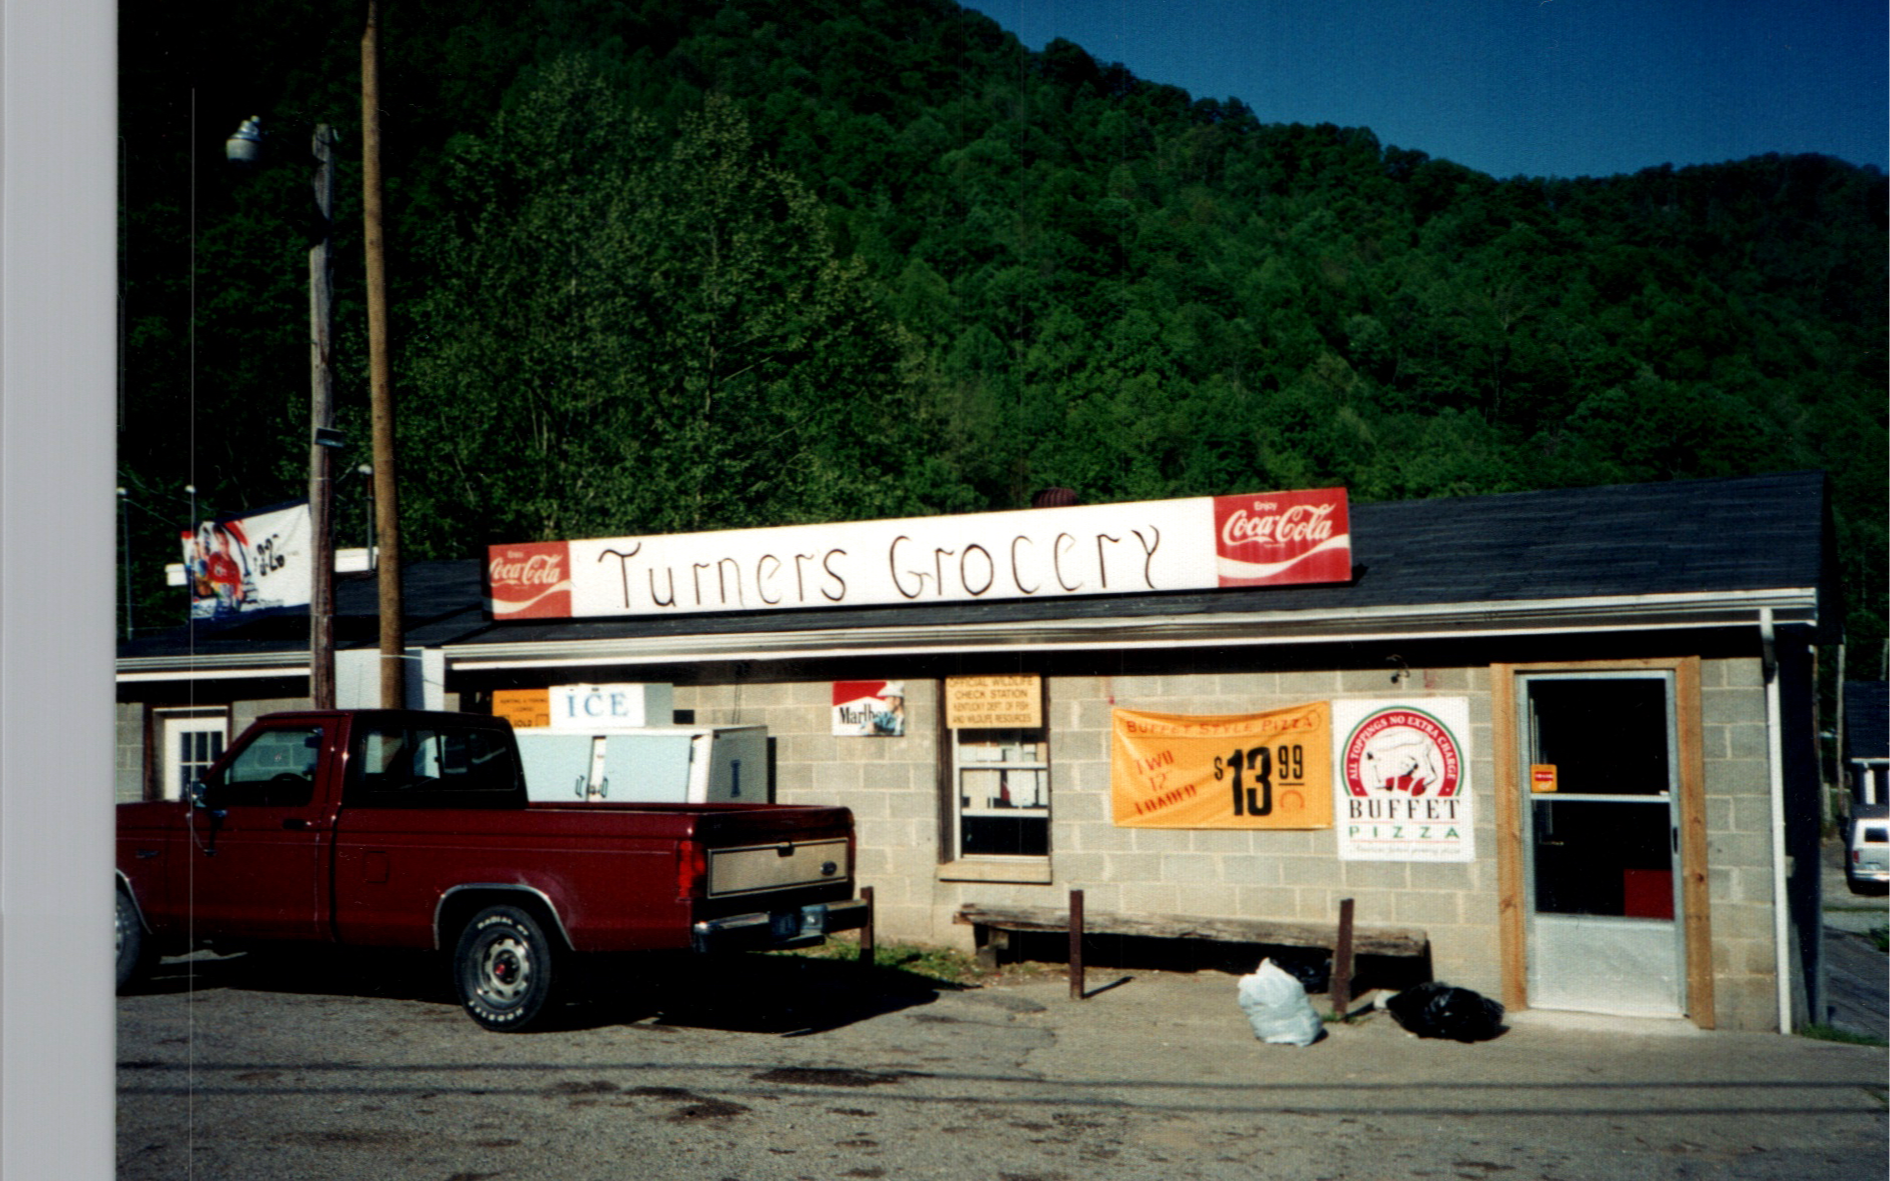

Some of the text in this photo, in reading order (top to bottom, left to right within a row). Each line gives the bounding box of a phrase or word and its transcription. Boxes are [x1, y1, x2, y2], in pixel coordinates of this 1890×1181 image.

[1254, 501, 1277, 511] Enjoy
[1222, 503, 1336, 546] Coca-Cola
[490, 555, 563, 587] Coca-Cola
[598, 525, 1160, 609] Turners Grocery
[567, 692, 629, 718] ICE
[955, 690, 1027, 699] CHECK STATION
[1348, 715, 1457, 780] ALL TOPPINGS NO EXTRA CHARGE
[1350, 799, 1460, 819] BUFFET
[1349, 826, 1460, 838] PIZZA
